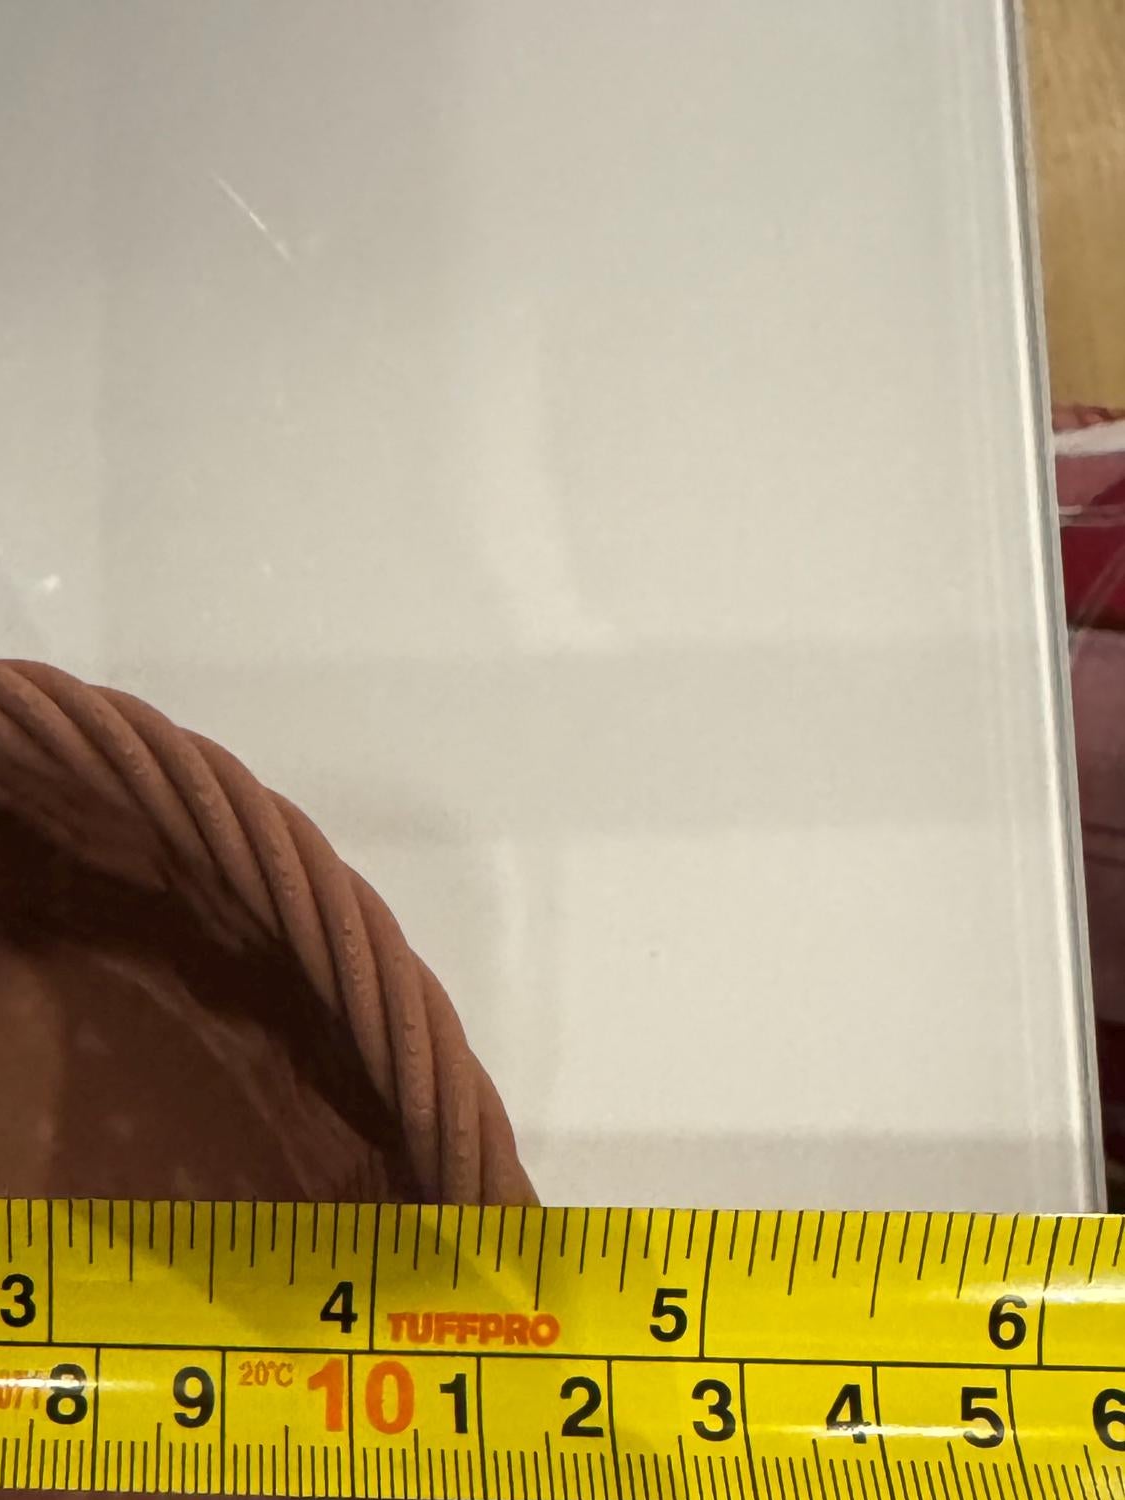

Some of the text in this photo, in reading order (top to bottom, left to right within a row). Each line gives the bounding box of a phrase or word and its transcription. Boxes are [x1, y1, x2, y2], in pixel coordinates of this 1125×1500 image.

[0, 1273, 36, 1327] 3
[320, 1281, 358, 1333] 4
[387, 1312, 560, 1347] TUFFPRO
[649, 1288, 688, 1342] 5
[988, 1295, 1027, 1350] 6
[45, 1363, 88, 1425] 8
[174, 1366, 215, 1428] 9
[307, 1358, 415, 1435] 10
[439, 1373, 469, 1434] 1
[560, 1376, 604, 1438] 2
[692, 1379, 736, 1442] 3
[825, 1383, 872, 1444] 4
[960, 1387, 1005, 1449] 5
[1092, 1388, 1125, 1452] 6
